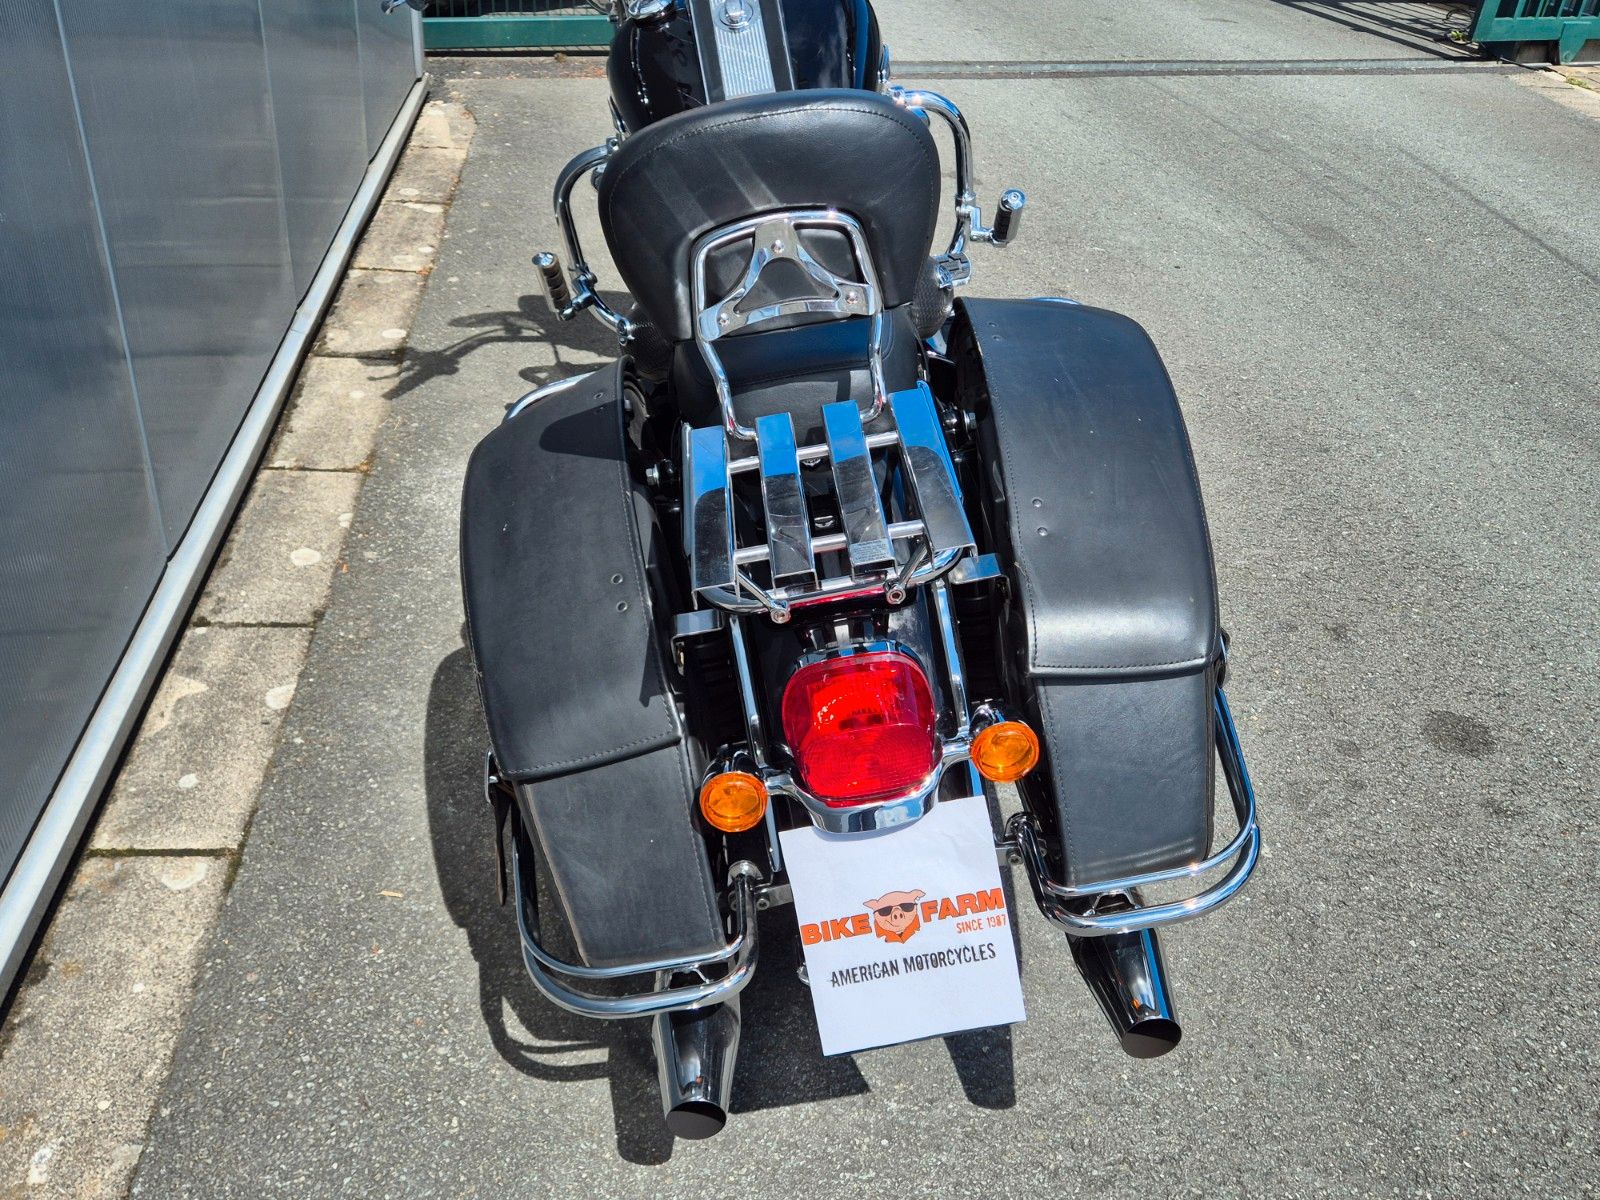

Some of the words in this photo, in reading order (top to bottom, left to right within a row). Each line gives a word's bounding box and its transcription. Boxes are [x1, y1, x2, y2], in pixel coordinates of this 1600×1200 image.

[800, 913, 872, 945] BIKE
[920, 887, 1005, 923] FARM
[956, 918, 984, 934] SINCE
[986, 914, 1006, 928] 1987
[831, 959, 899, 988] AMERICAN
[904, 942, 996, 973] MOTORCYCLES
